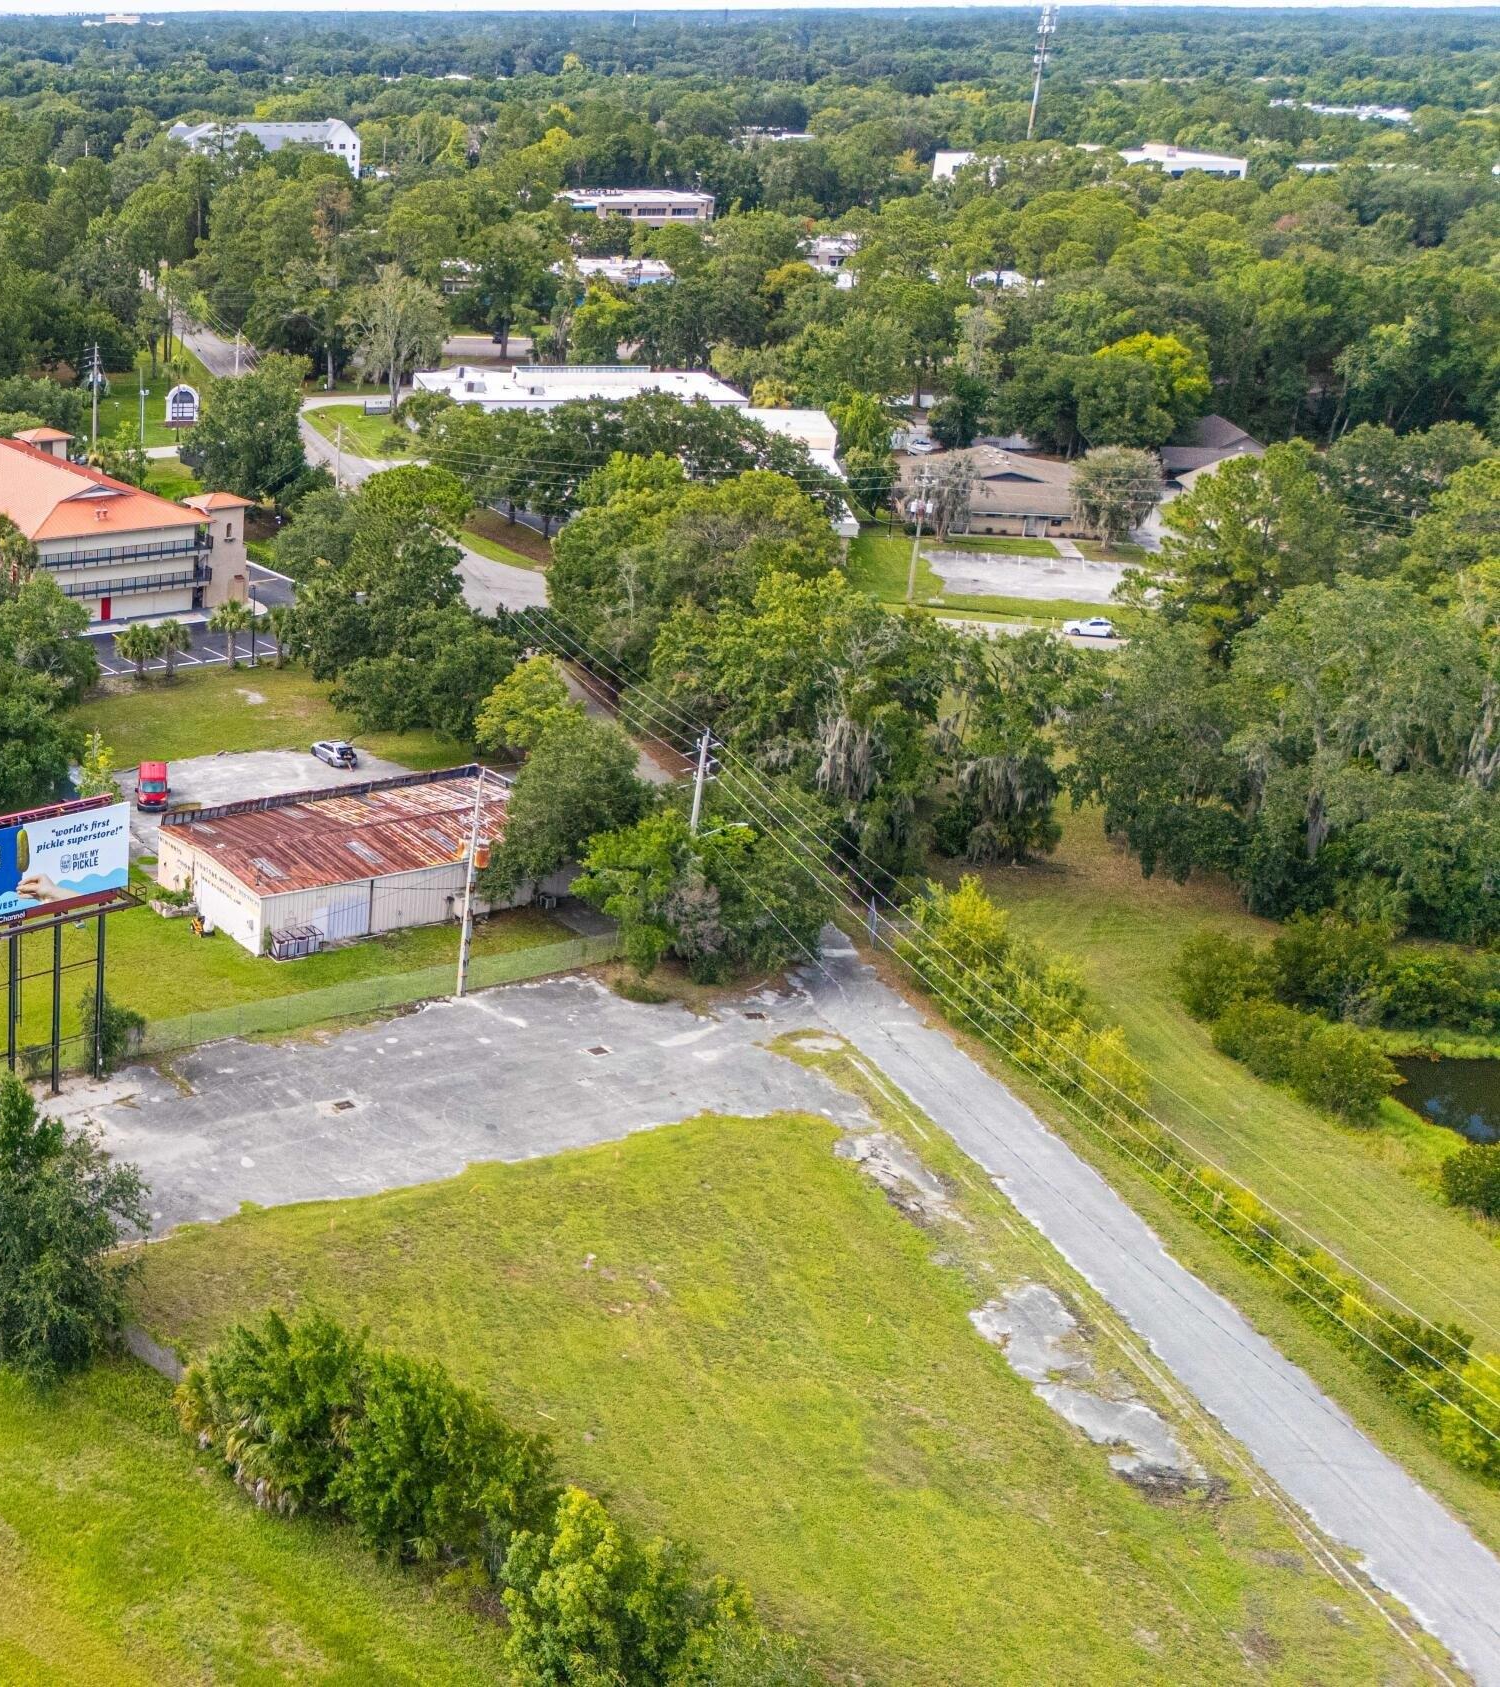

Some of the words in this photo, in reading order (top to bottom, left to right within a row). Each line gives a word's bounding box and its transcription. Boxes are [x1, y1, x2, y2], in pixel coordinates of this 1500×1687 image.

[91, 819, 110, 832] first
[36, 839, 65, 853] pickle
[72, 851, 88, 861] OLIVE
[89, 849, 99, 857] MY
[72, 857, 99, 871] PICKLE
